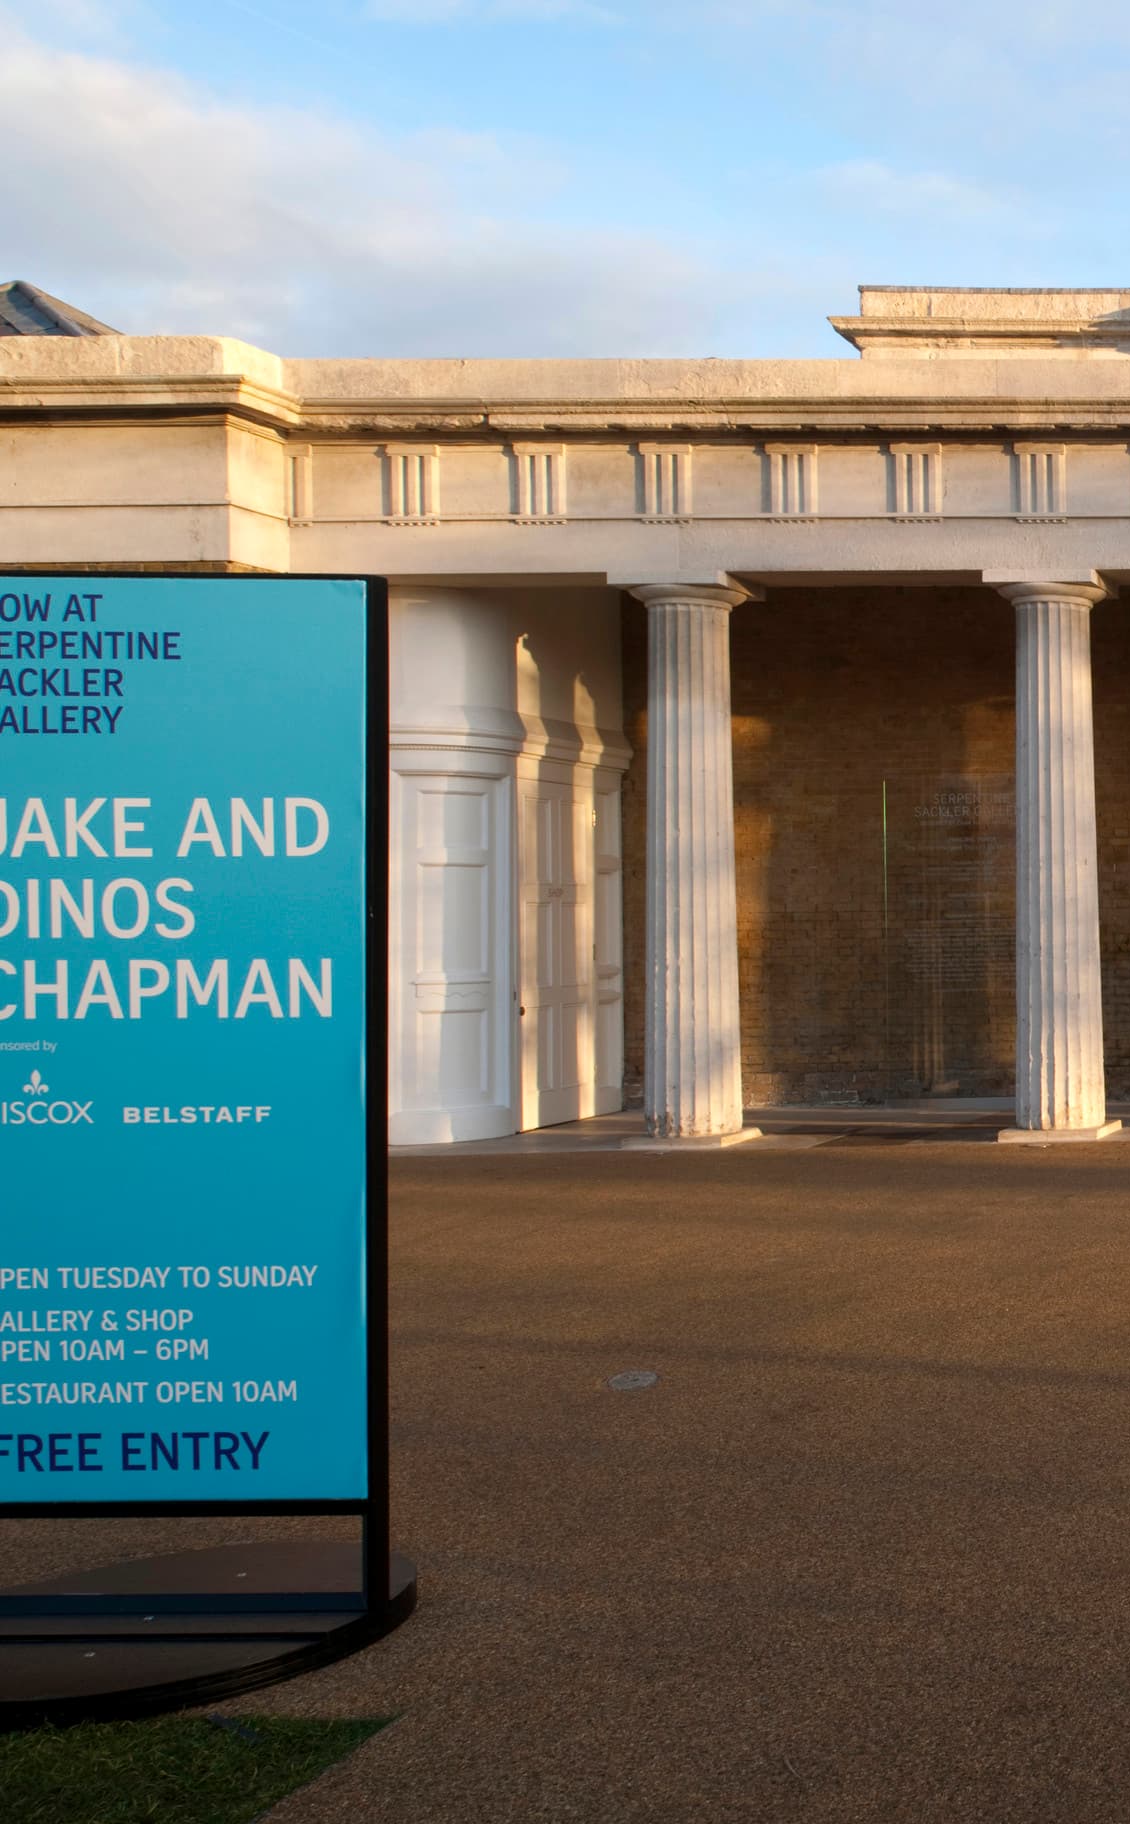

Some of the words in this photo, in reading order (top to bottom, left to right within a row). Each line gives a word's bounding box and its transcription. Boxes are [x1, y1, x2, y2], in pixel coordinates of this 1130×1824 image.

[62, 594, 103, 623] AT
[0, 668, 124, 697] ACKLER
[0, 705, 123, 734] ALLERY
[176, 797, 330, 858] AND
[42, 1040, 57, 1053] by
[2, 1101, 94, 1124] ISCOX
[123, 1106, 272, 1123] BELSTAFF
[0, 1267, 49, 1290] PEN
[58, 1266, 171, 1289] TUESDAY
[178, 1266, 211, 1288] TO
[217, 1265, 318, 1288] SUNDAY
[0, 1310, 94, 1333] ALLERY
[101, 1310, 118, 1332] &
[126, 1309, 194, 1332] SHOP
[1, 1340, 50, 1362] PEN
[59, 1339, 125, 1362] 10AM
[155, 1338, 209, 1361] 6PM
[1, 1381, 149, 1405] ESTAURANT
[156, 1380, 223, 1403] OPEN
[232, 1380, 297, 1403] 10AM
[121, 1431, 270, 1472] ENTRY
